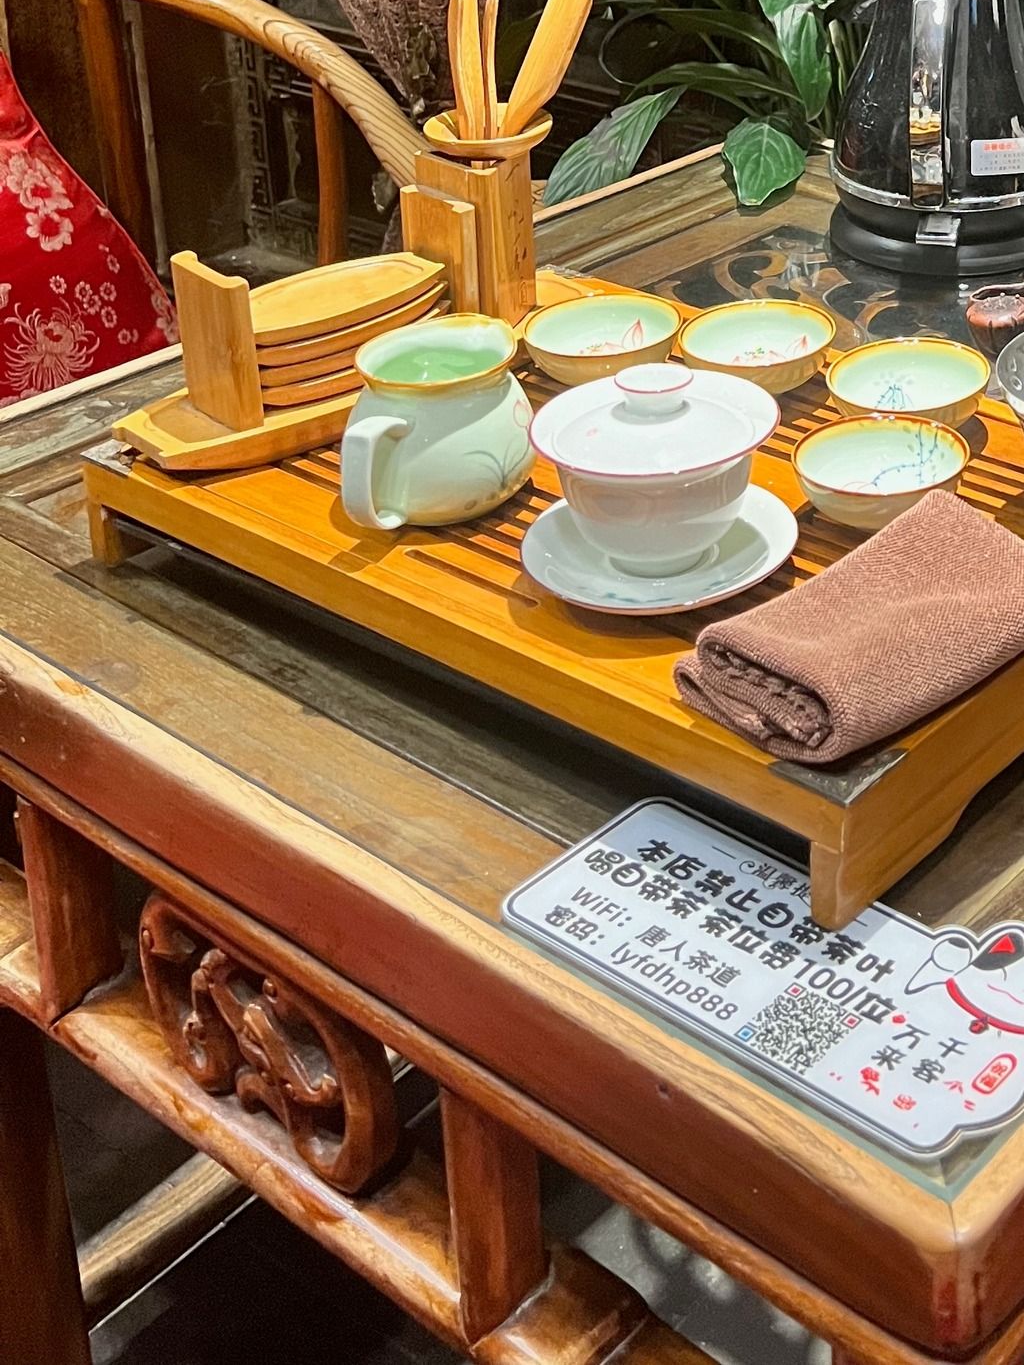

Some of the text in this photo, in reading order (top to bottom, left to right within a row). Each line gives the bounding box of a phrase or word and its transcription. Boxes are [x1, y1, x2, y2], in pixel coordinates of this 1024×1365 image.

[637, 838, 896, 983] 本店禁止自带茶叶
[610, 941, 739, 1022] lyfdhp888
[635, 925, 742, 989] 唐人茶道
